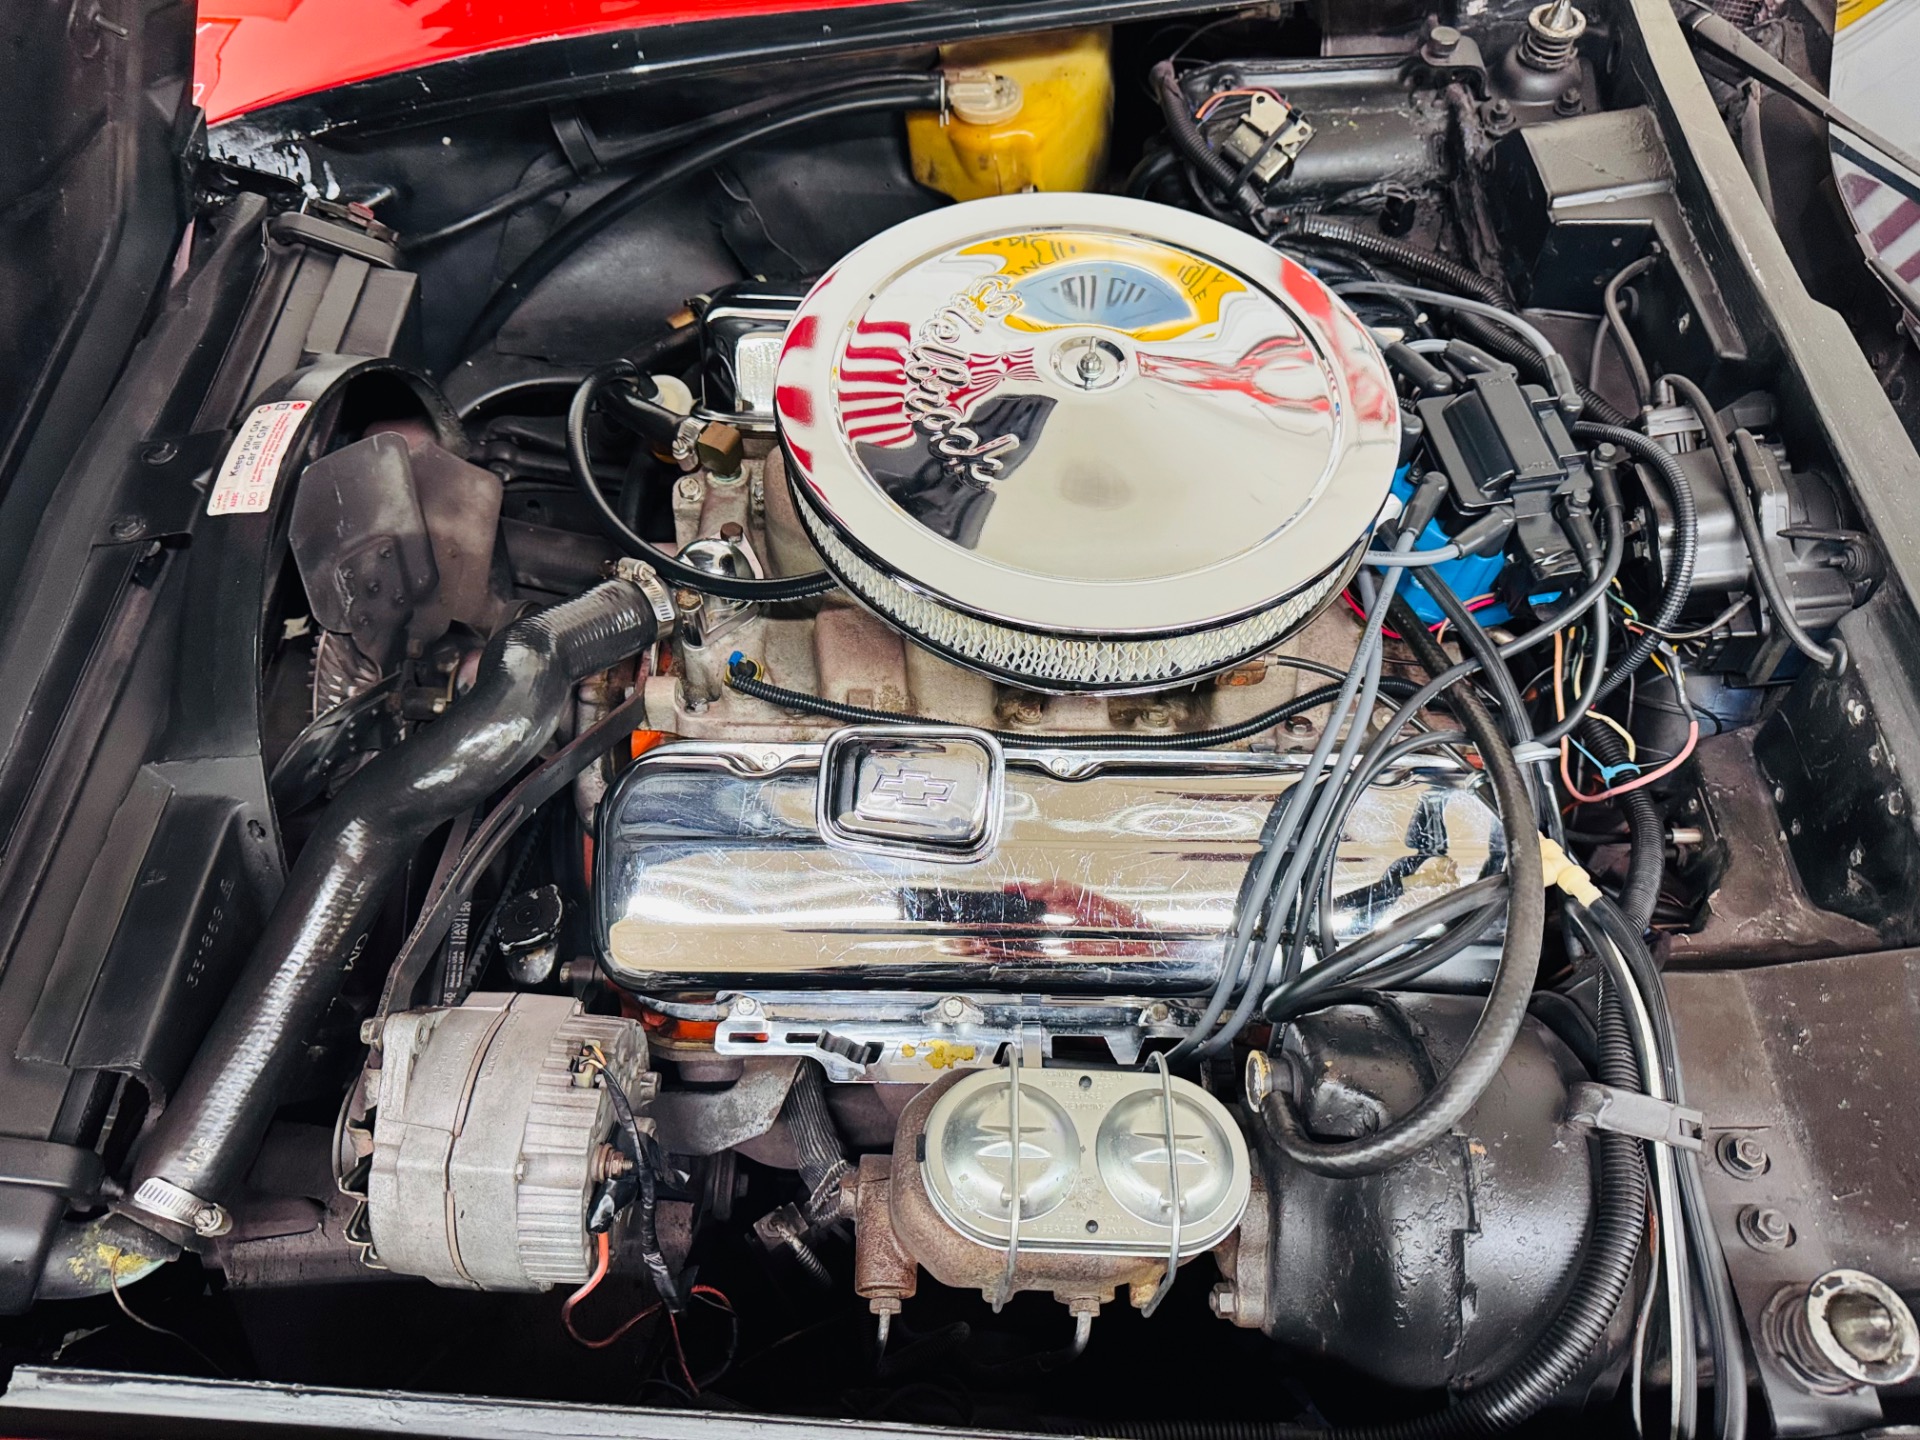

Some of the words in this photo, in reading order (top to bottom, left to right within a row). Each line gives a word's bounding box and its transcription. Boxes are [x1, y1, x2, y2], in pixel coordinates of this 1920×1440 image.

[904, 273, 1023, 489] Edelbrock
[229, 455, 245, 477] Keep
[242, 434, 254, 452] your
[250, 420, 262, 433] GM
[253, 440, 262, 450] all
[257, 425, 269, 439] GM
[246, 453, 256, 466] car
[1360, 612, 1382, 656] SUPPRESSION
[1379, 592, 1390, 611] CORE
